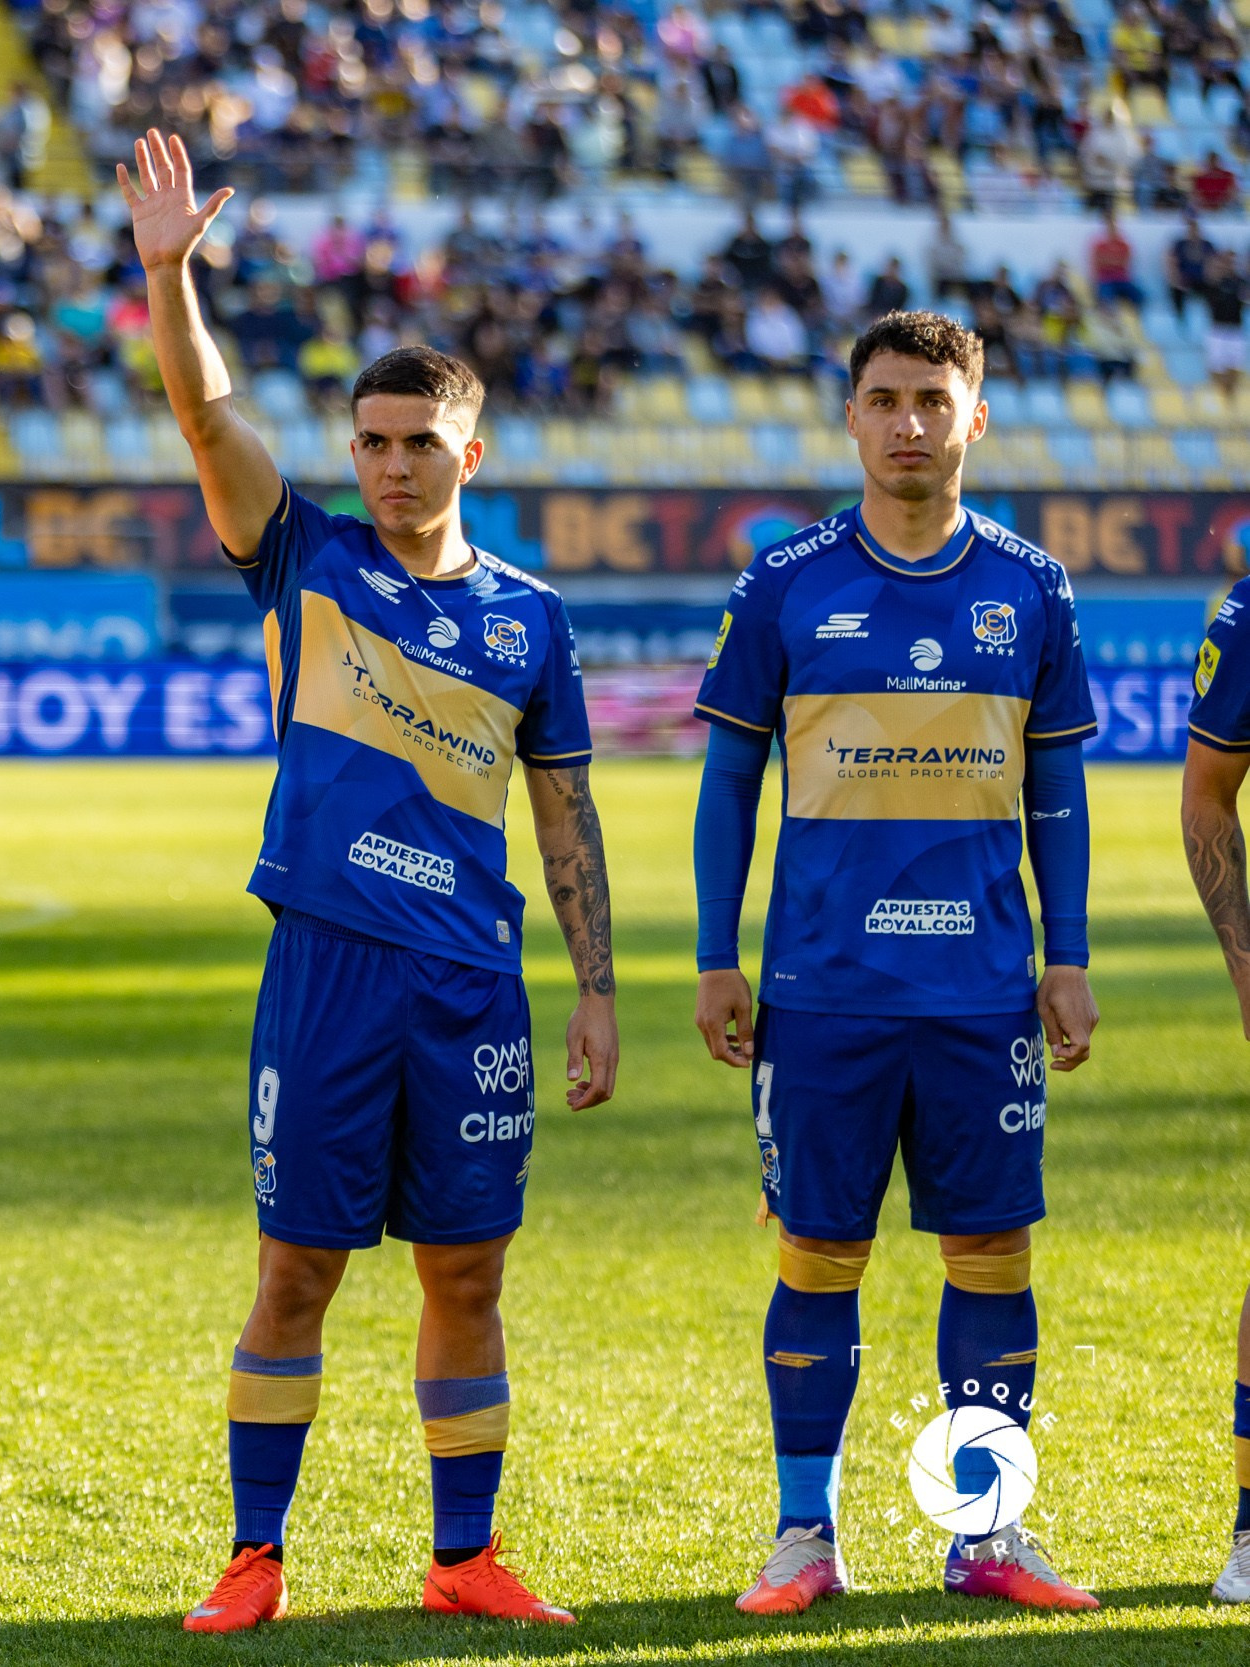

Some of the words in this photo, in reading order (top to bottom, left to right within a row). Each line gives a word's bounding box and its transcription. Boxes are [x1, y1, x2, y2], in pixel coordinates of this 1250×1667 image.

[766, 530, 838, 568] Claro
[979, 523, 1047, 568] Claro
[815, 630, 869, 639] SKECHERS
[396, 636, 467, 677] MallMarina
[887, 676, 961, 691] MallMarina
[163, 669, 267, 750] ES
[402, 729, 491, 780] PROTECTION
[836, 747, 1006, 765] TERRAWIND
[837, 769, 900, 779] GLOBAL
[911, 769, 1005, 779] PROTECTION
[351, 848, 454, 892] ROYAL.COM
[360, 835, 453, 875] APUESTAS
[868, 918, 973, 932] ROYAL.COM
[875, 902, 968, 916] APUESTAS
[253, 1066, 281, 1145] 9
[755, 1061, 775, 1138] 7
[460, 1111, 532, 1143] Claro
